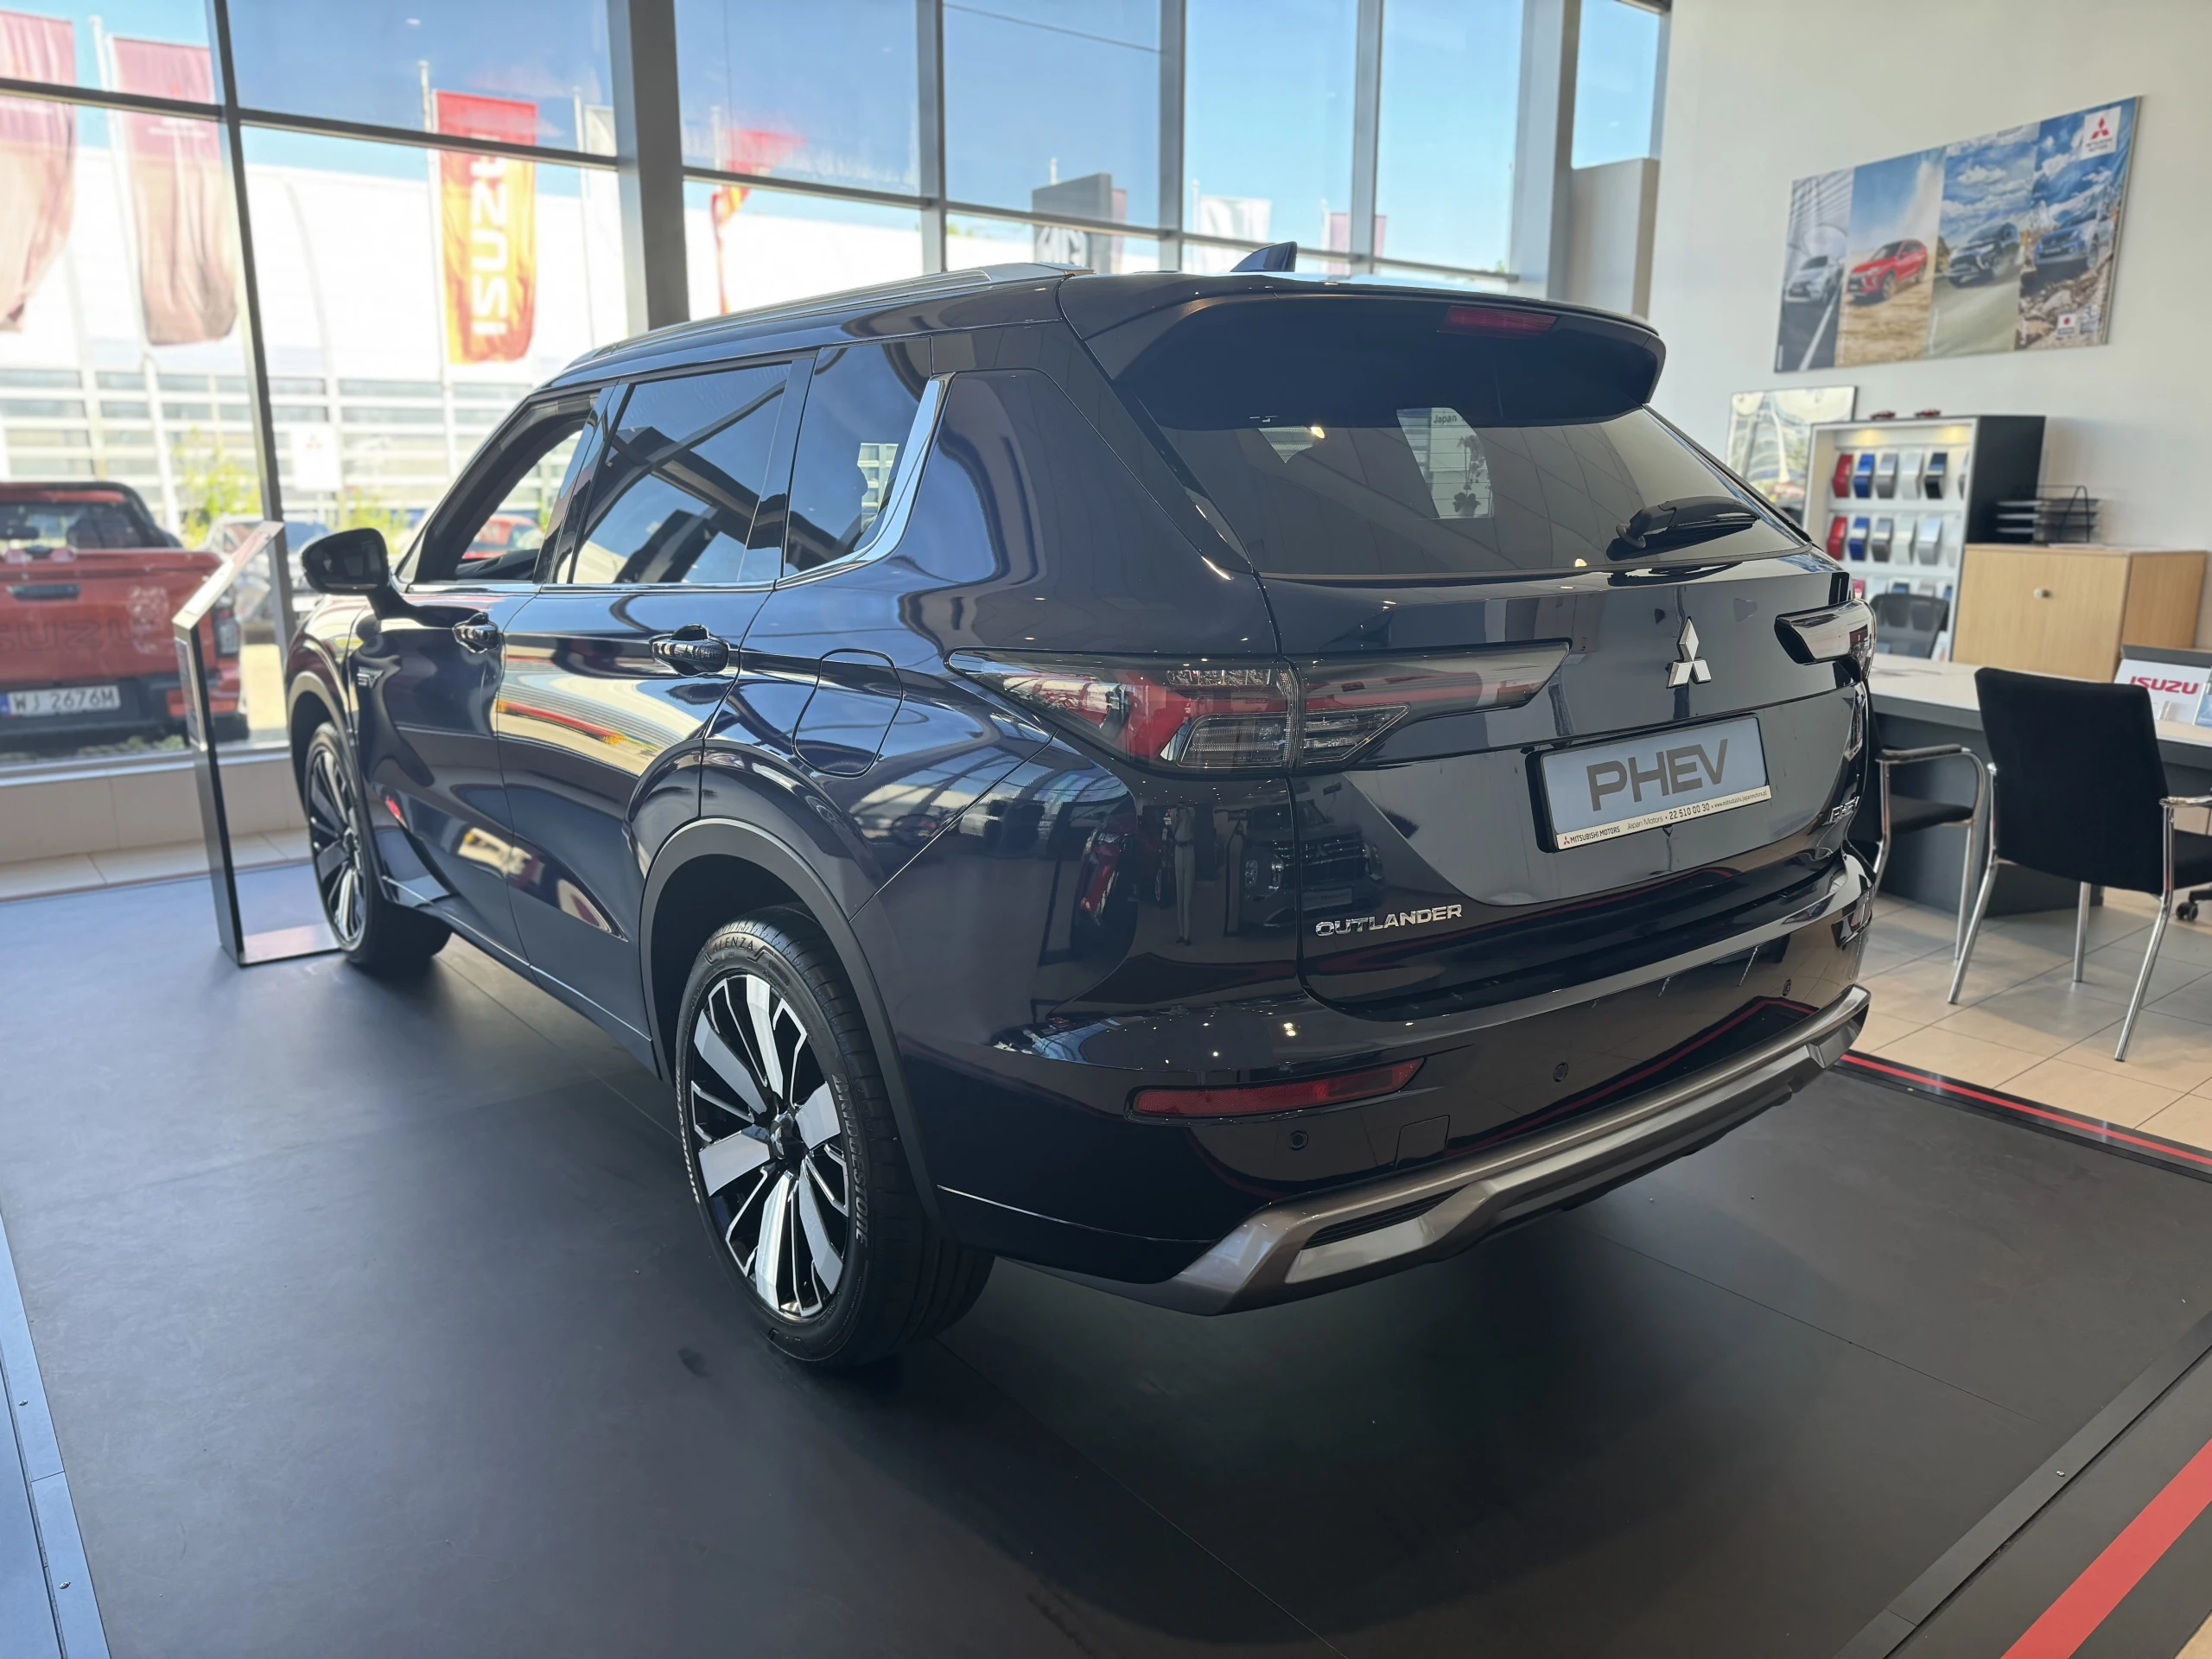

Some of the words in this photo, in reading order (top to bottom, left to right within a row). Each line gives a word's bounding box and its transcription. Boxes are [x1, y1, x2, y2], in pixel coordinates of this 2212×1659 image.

[1433, 415, 1457, 425] Japan
[2130, 676, 2199, 695] ISUZU
[51, 689, 114, 710] 2676M
[1586, 739, 1728, 811] PHEV
[1570, 831, 1599, 843] MITSUBISHI
[1600, 826, 1620, 836] MOTORS
[1627, 820, 1643, 830] Japan
[1643, 816, 1663, 826] Motors
[1669, 810, 1678, 820] 22
[1679, 807, 1691, 817] 510
[1692, 804, 1701, 814] 00
[1701, 803, 1710, 812] 30
[1315, 904, 1463, 937] OUTLANDER
[713, 937, 753, 954] ALENZA
[830, 1072, 868, 1248] BRIDGESTONE
